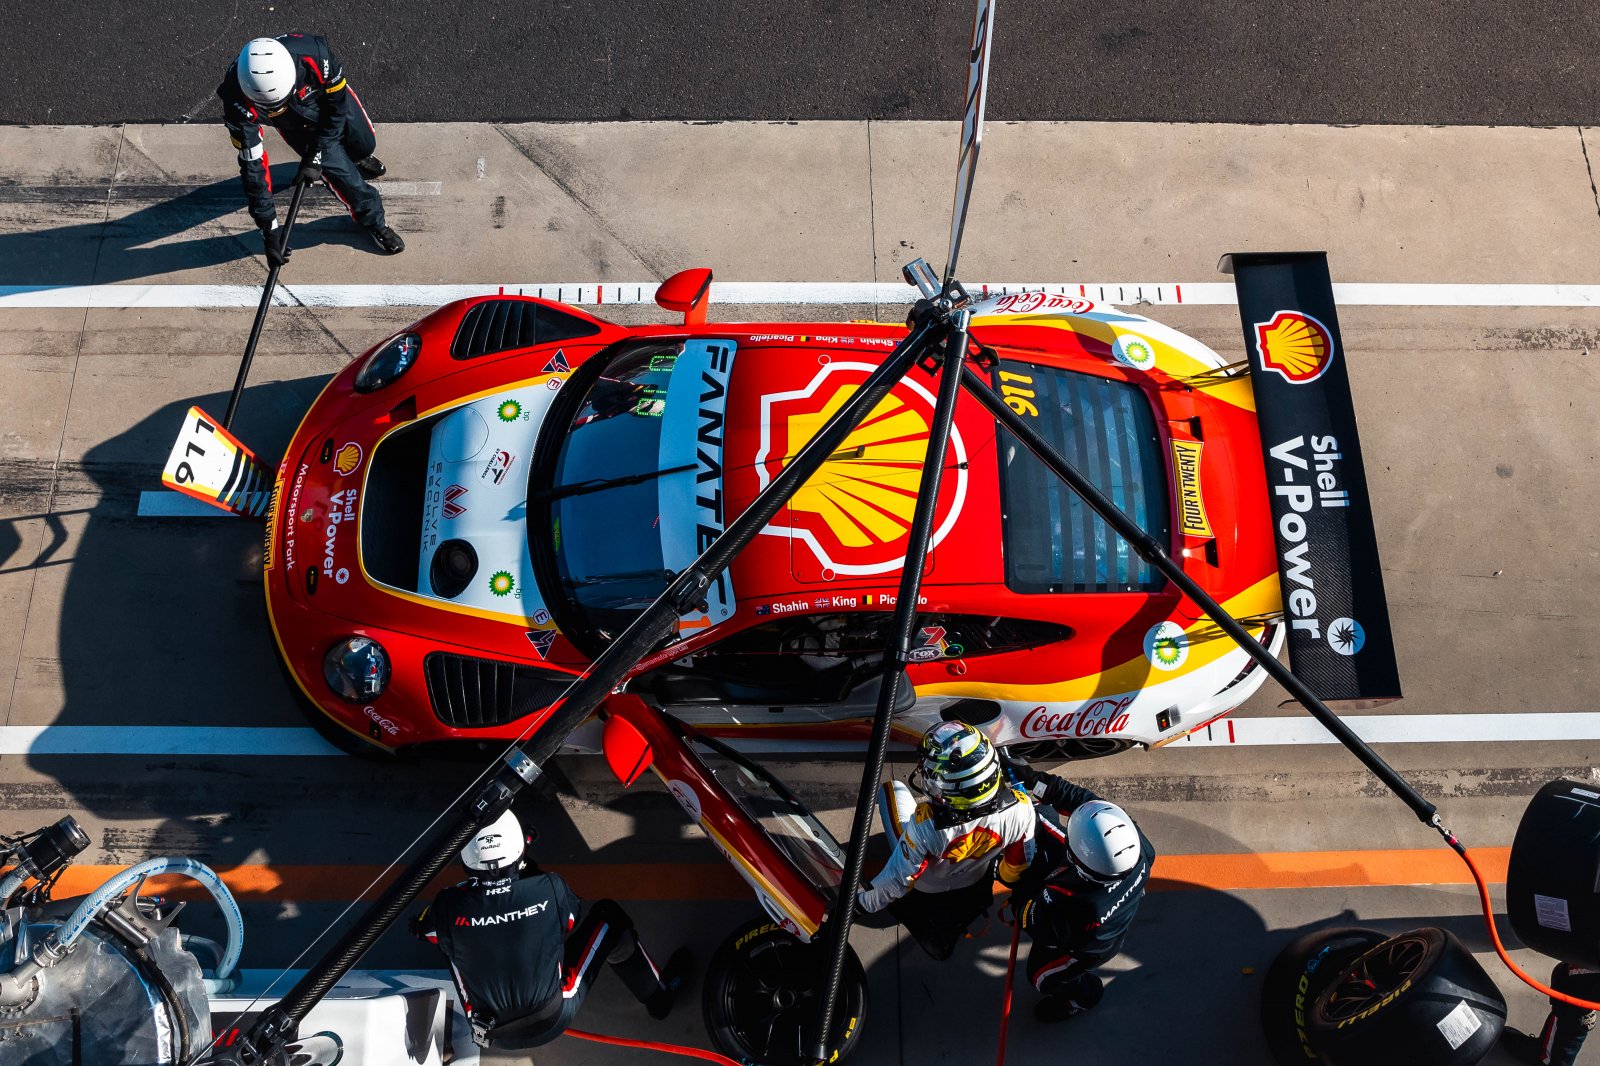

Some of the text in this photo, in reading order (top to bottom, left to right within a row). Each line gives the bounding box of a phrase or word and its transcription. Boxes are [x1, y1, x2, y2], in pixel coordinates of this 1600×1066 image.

[992, 291, 1095, 314] Coca-Cola
[816, 335, 838, 344] King
[860, 337, 893, 347] Shahin
[522, 411, 530, 422] bp
[174, 417, 216, 484] 911
[1176, 445, 1197, 489] TWENTY
[1310, 435, 1350, 507] Shell
[286, 463, 309, 571] Motorsport Park
[343, 488, 357, 521] Shell
[422, 463, 436, 553] TECHNIK
[430, 462, 443, 546] EVOLVE
[323, 489, 345, 578] V-Power
[1269, 435, 1320, 639] V-Power
[514, 588, 523, 599] bp
[772, 594, 928, 614] Shahin King Piclo
[363, 705, 400, 736] Coca-Cola
[1019, 697, 1137, 739] Coca-Cola
[486, 886, 511, 896] HRX
[471, 900, 549, 927] MANTHEY
[1337, 979, 1413, 1029] PIRELLI
